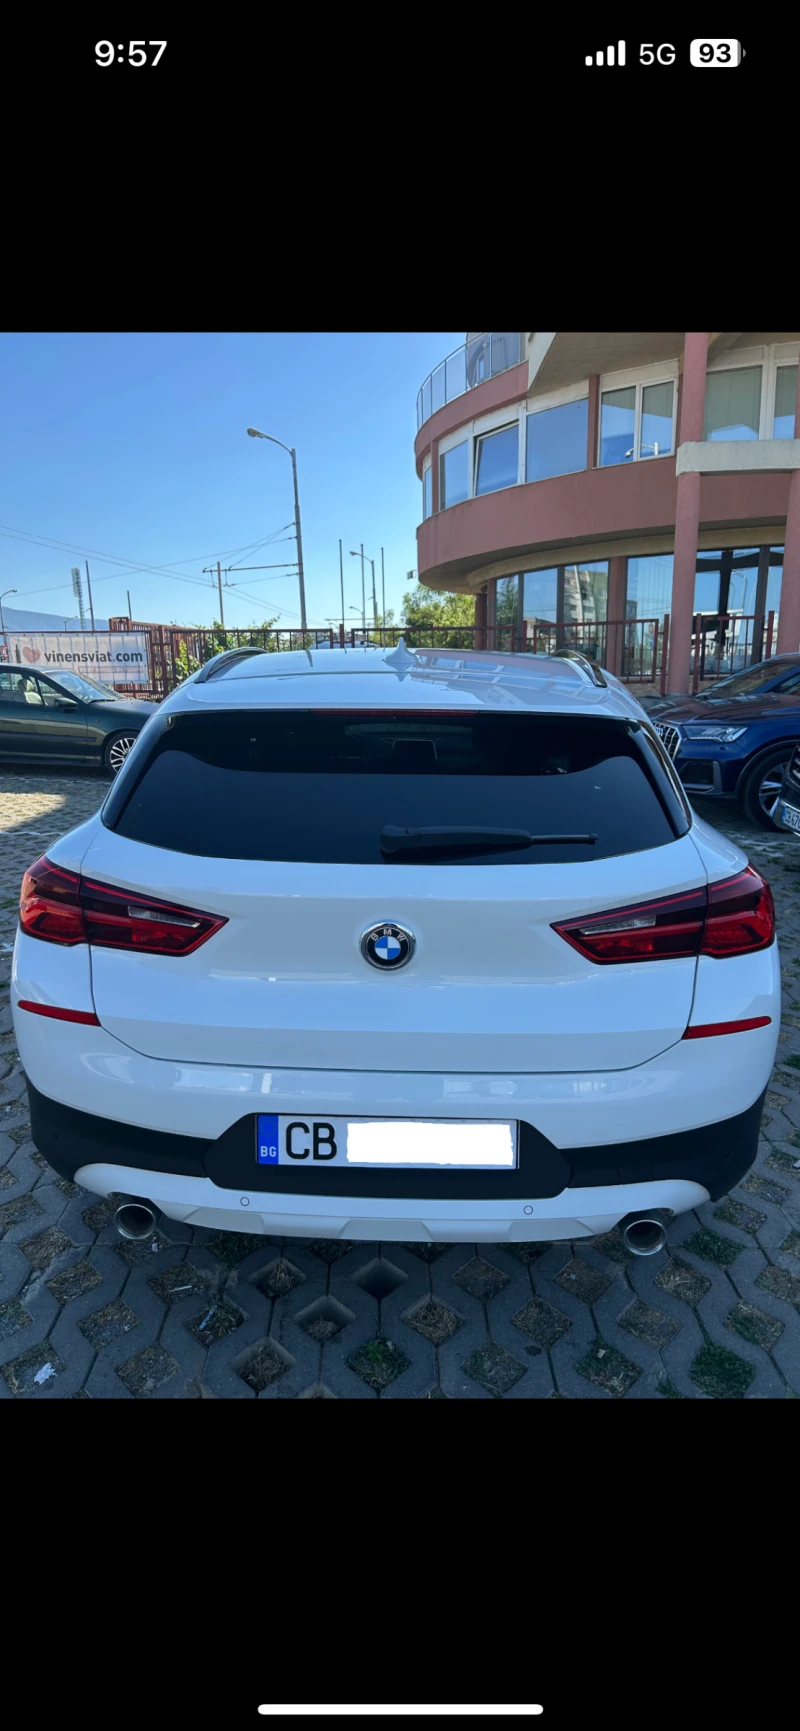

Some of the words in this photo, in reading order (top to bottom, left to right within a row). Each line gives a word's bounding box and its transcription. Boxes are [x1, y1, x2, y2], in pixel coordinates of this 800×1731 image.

[44, 650, 143, 662] vinensviat.com
[370, 928, 406, 942] BMW
[286, 1122, 337, 1160] CB
[260, 1146, 277, 1157] BG
